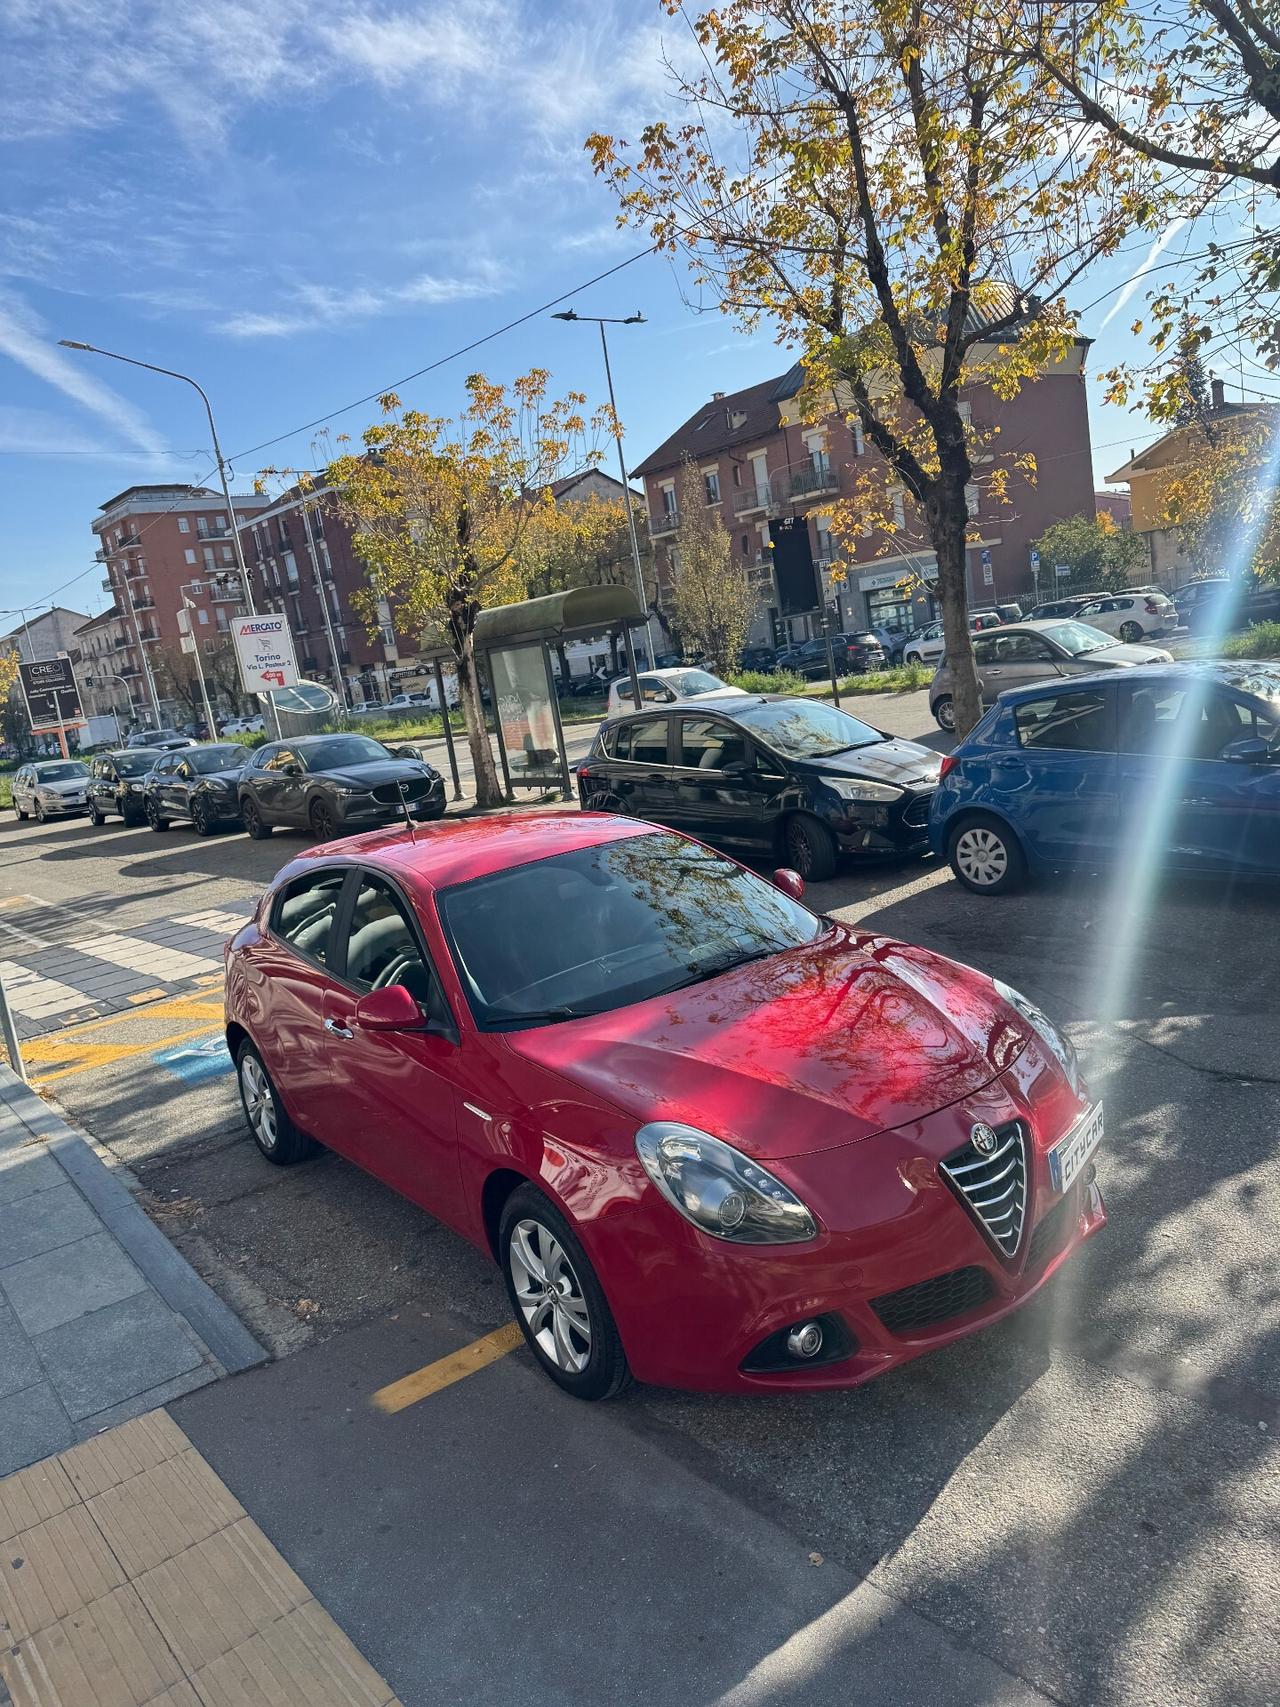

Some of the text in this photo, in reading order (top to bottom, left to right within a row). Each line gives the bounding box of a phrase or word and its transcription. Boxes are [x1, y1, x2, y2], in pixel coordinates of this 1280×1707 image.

[1032, 552, 1037, 561] P
[254, 653, 281, 662] Torino
[32, 664, 60, 675] CREO
[1065, 1112, 1103, 1181] CITYCAR
